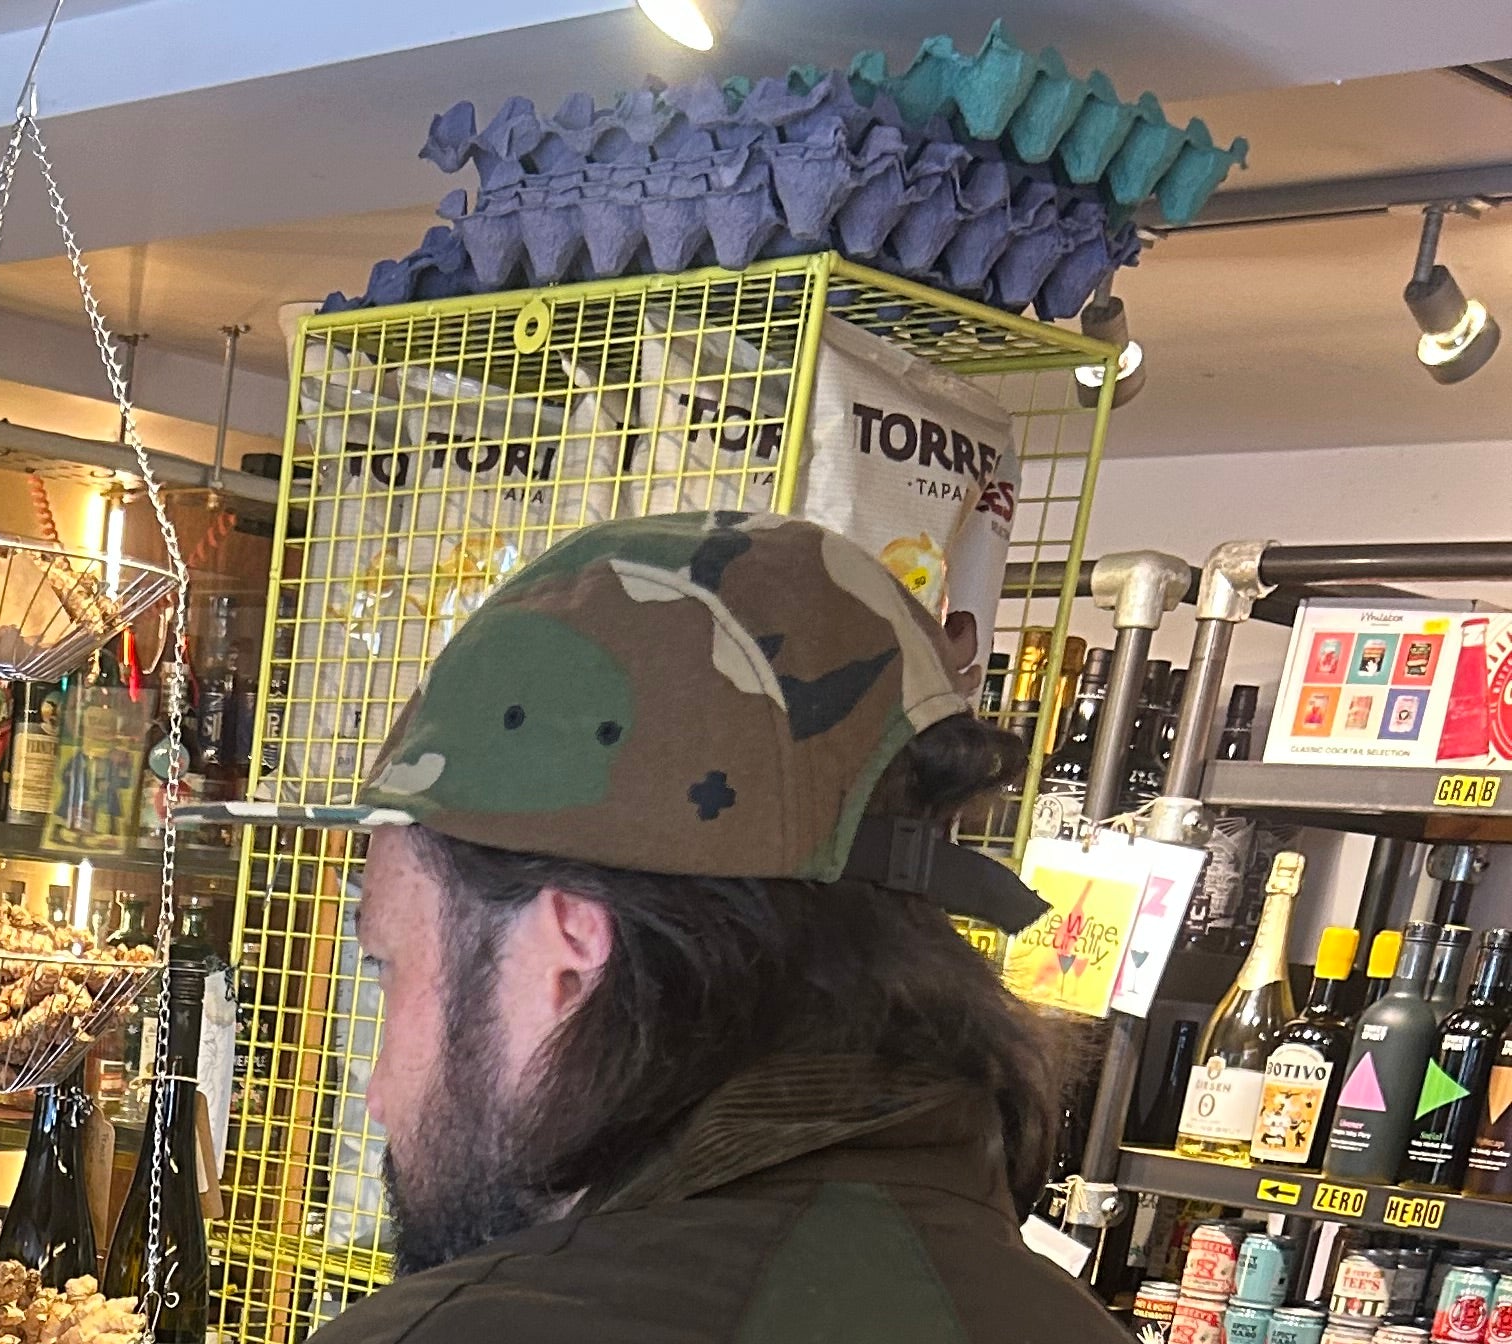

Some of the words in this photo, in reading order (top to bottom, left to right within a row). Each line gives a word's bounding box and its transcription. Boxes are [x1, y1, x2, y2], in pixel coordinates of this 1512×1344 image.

[853, 402, 1002, 490] TORRE
[916, 478, 962, 502] TAPA
[1290, 746, 1323, 755] CLASSIC
[1326, 747, 1364, 757] COCKTAIL
[1366, 748, 1411, 759] SELECTION
[1437, 779, 1496, 803] GRAB
[1316, 1186, 1363, 1215] ZERO
[1388, 1200, 1441, 1227] HERO
